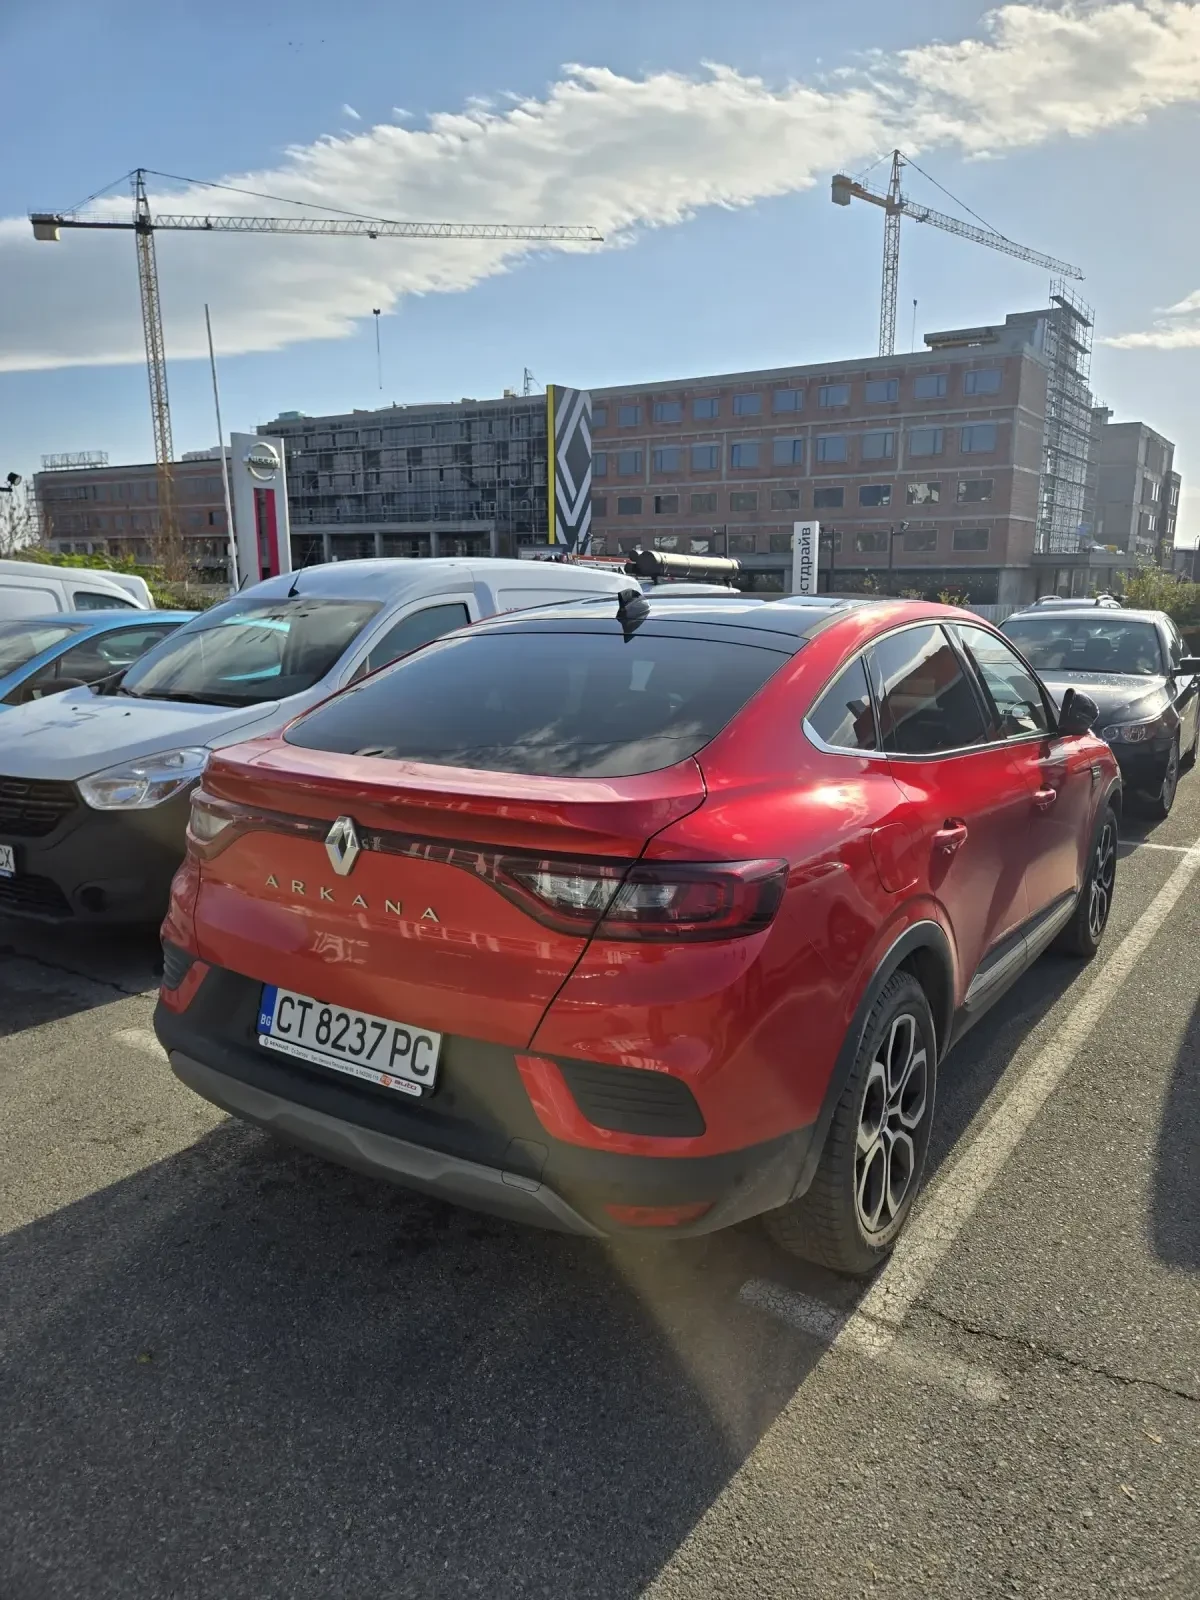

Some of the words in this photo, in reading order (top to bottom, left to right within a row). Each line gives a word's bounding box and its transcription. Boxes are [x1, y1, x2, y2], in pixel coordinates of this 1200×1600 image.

[265, 874, 440, 923] ARKANA
[260, 1014, 272, 1027] BG
[315, 1007, 387, 1061] 8237
